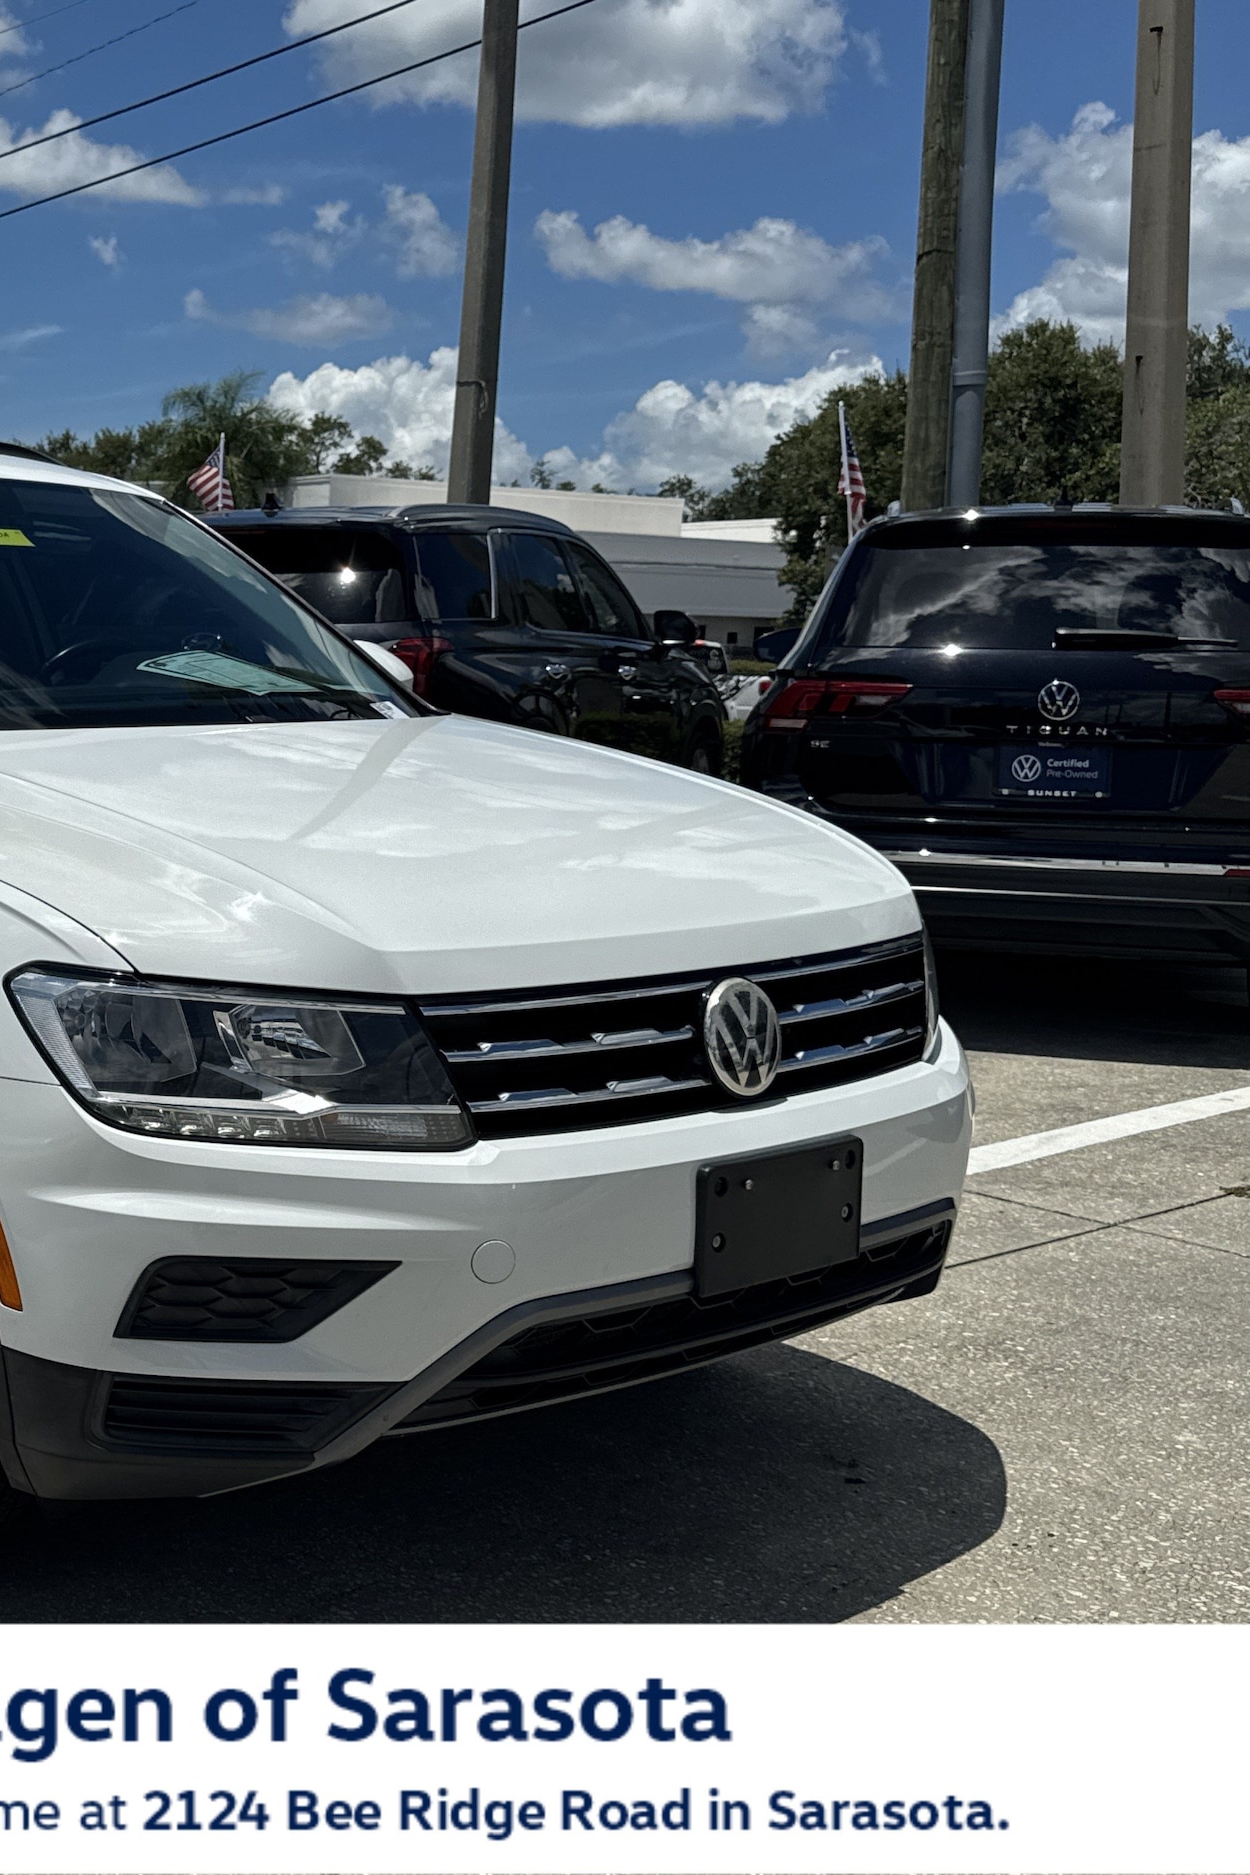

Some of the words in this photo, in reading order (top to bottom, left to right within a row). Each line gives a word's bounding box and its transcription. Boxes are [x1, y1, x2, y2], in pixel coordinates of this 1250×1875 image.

[1038, 681, 1080, 720] VW
[1006, 725, 1108, 736] TIGUAN
[1012, 754, 1041, 782] VW
[1047, 758, 1090, 768] Certified
[1046, 769, 1098, 779] Pre-Owned
[1027, 789, 1077, 797] SUNSET
[705, 977, 782, 1096] VW
